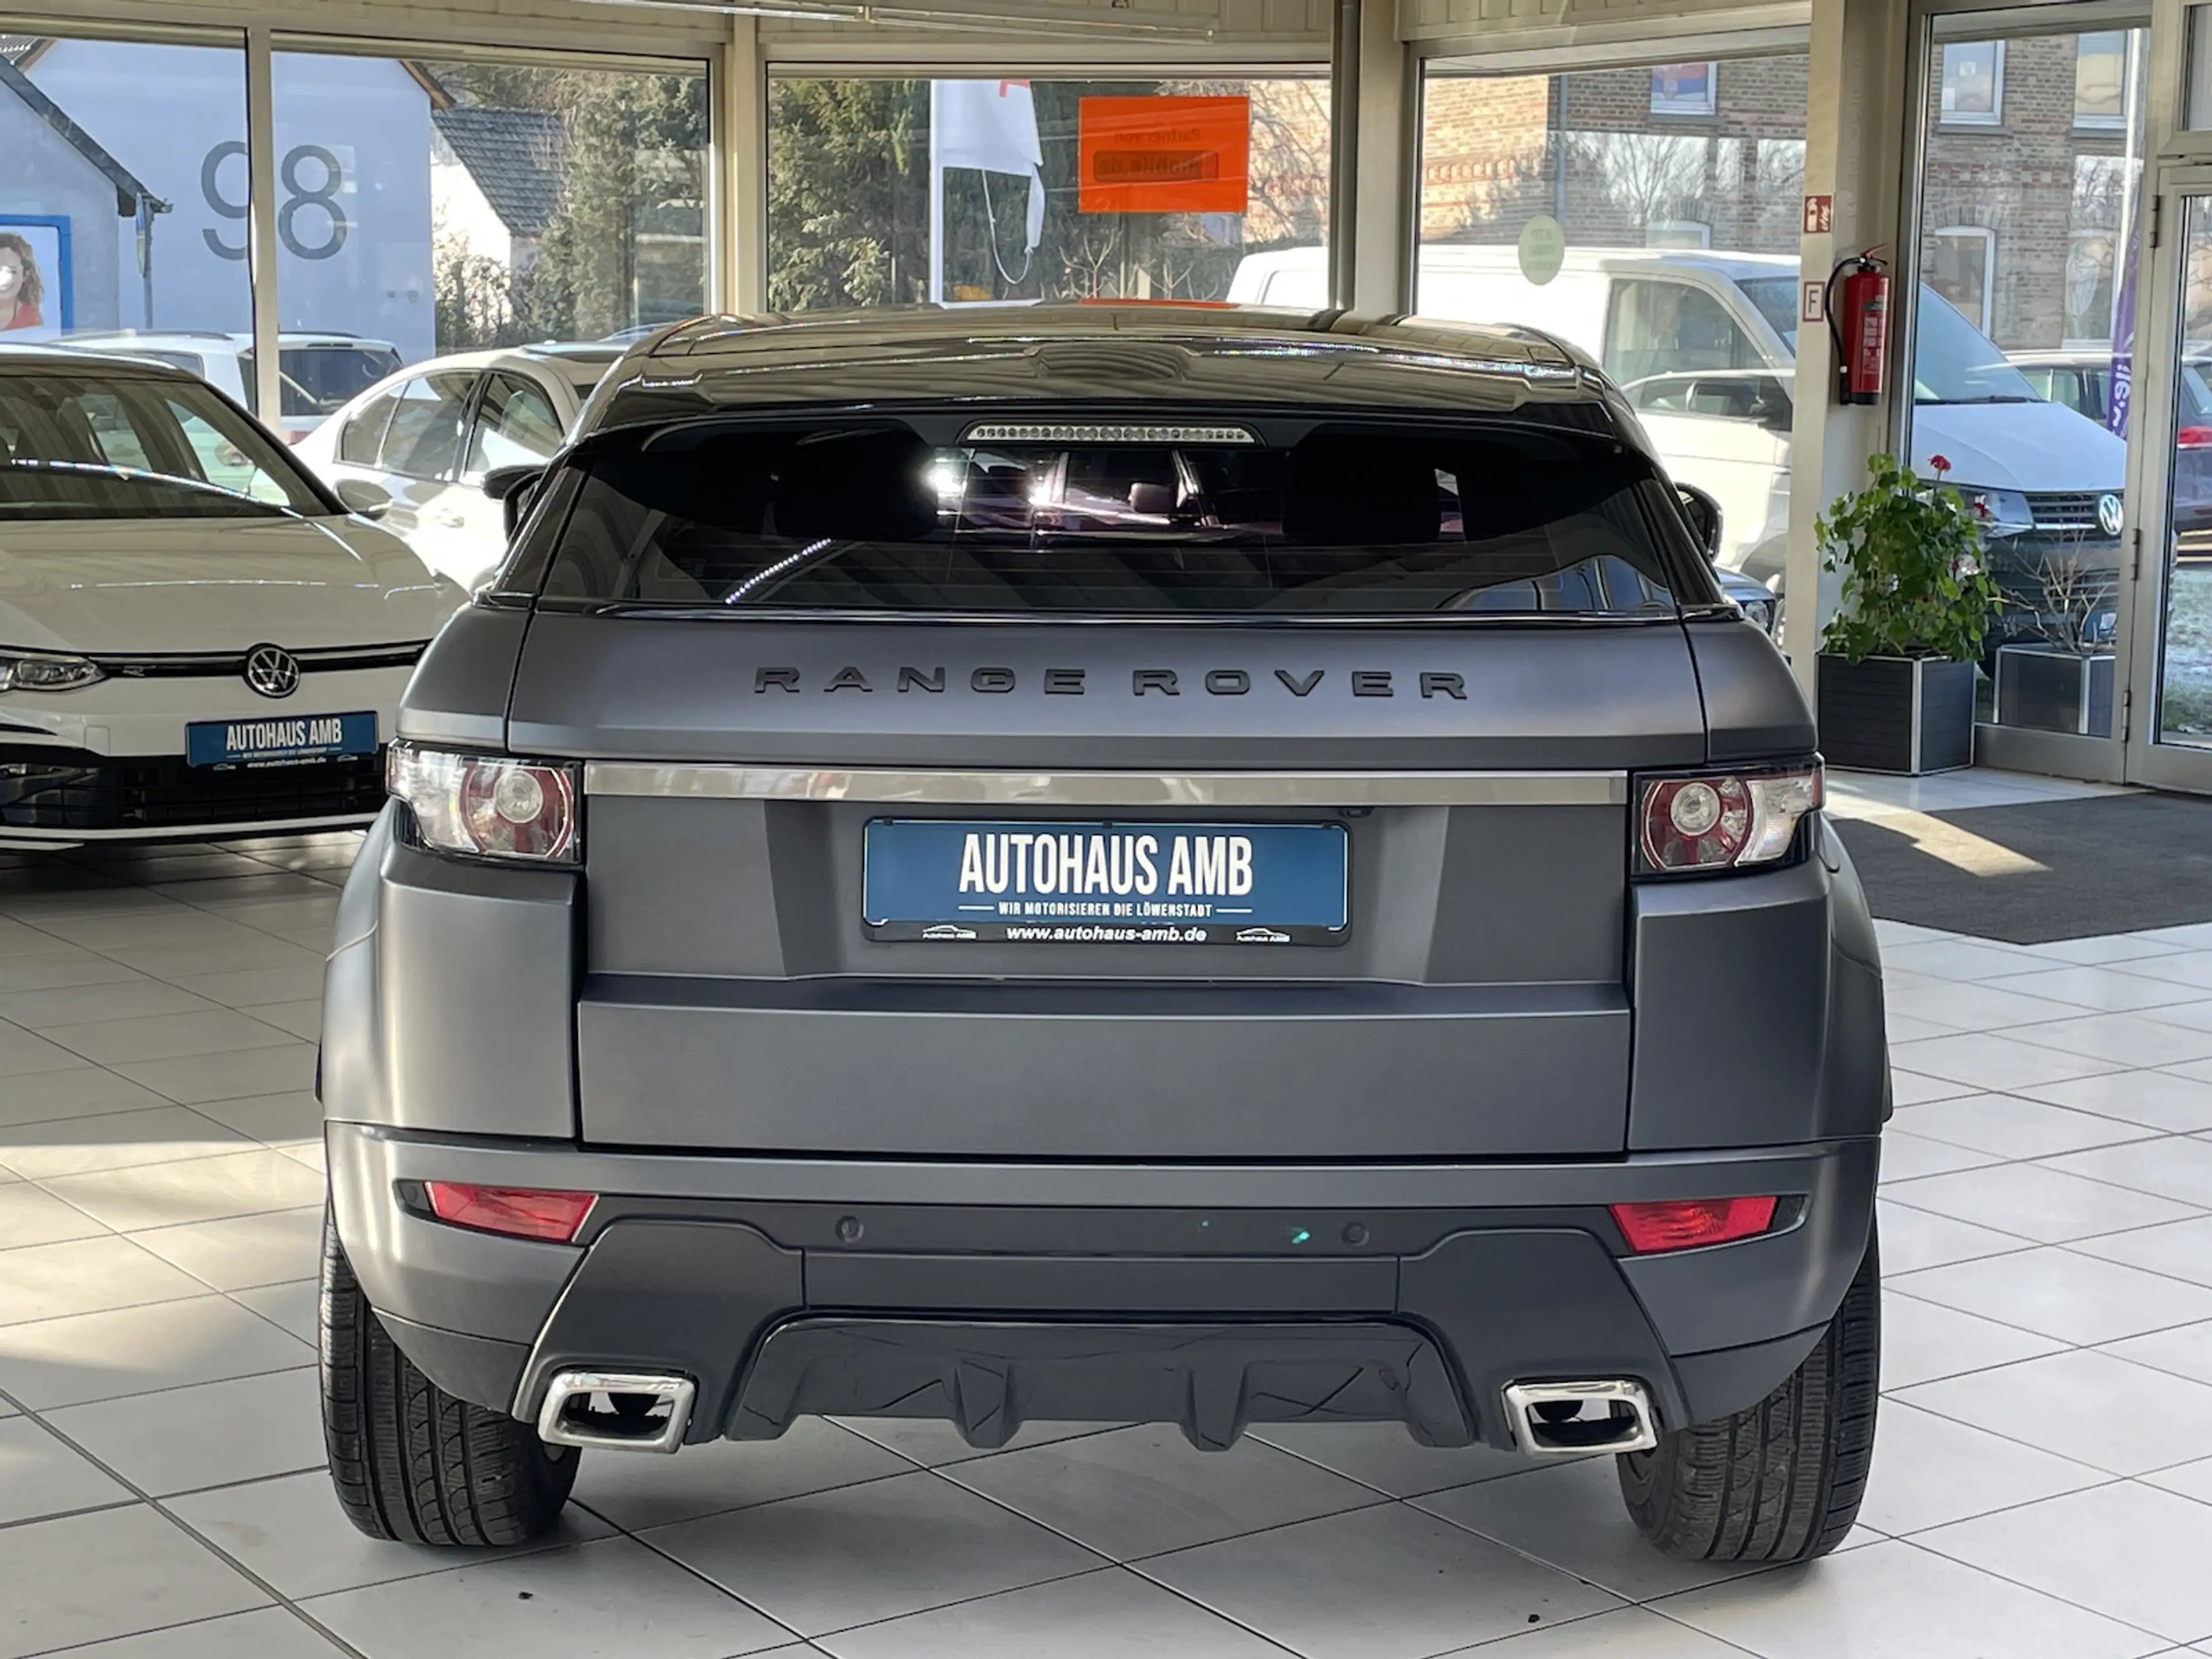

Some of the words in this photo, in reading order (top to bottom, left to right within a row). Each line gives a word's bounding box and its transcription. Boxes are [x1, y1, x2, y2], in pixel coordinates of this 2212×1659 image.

[201, 141, 348, 260] 98
[1808, 289, 1819, 313] F
[754, 666, 1085, 695] RANGE
[1132, 670, 1468, 700] ROVER
[226, 721, 306, 751] AUTOHAUS
[309, 718, 342, 745] AMB
[959, 833, 1158, 894] AUTOHAUS
[1168, 836, 1253, 896] AMB
[999, 902, 1021, 915] WIR
[1024, 902, 1111, 916] MOTORISIEREN
[1114, 903, 1133, 916] DIE
[1137, 902, 1213, 917] LÖWENSTADT
[1006, 926, 1207, 942] www.autohaus-amb.de
